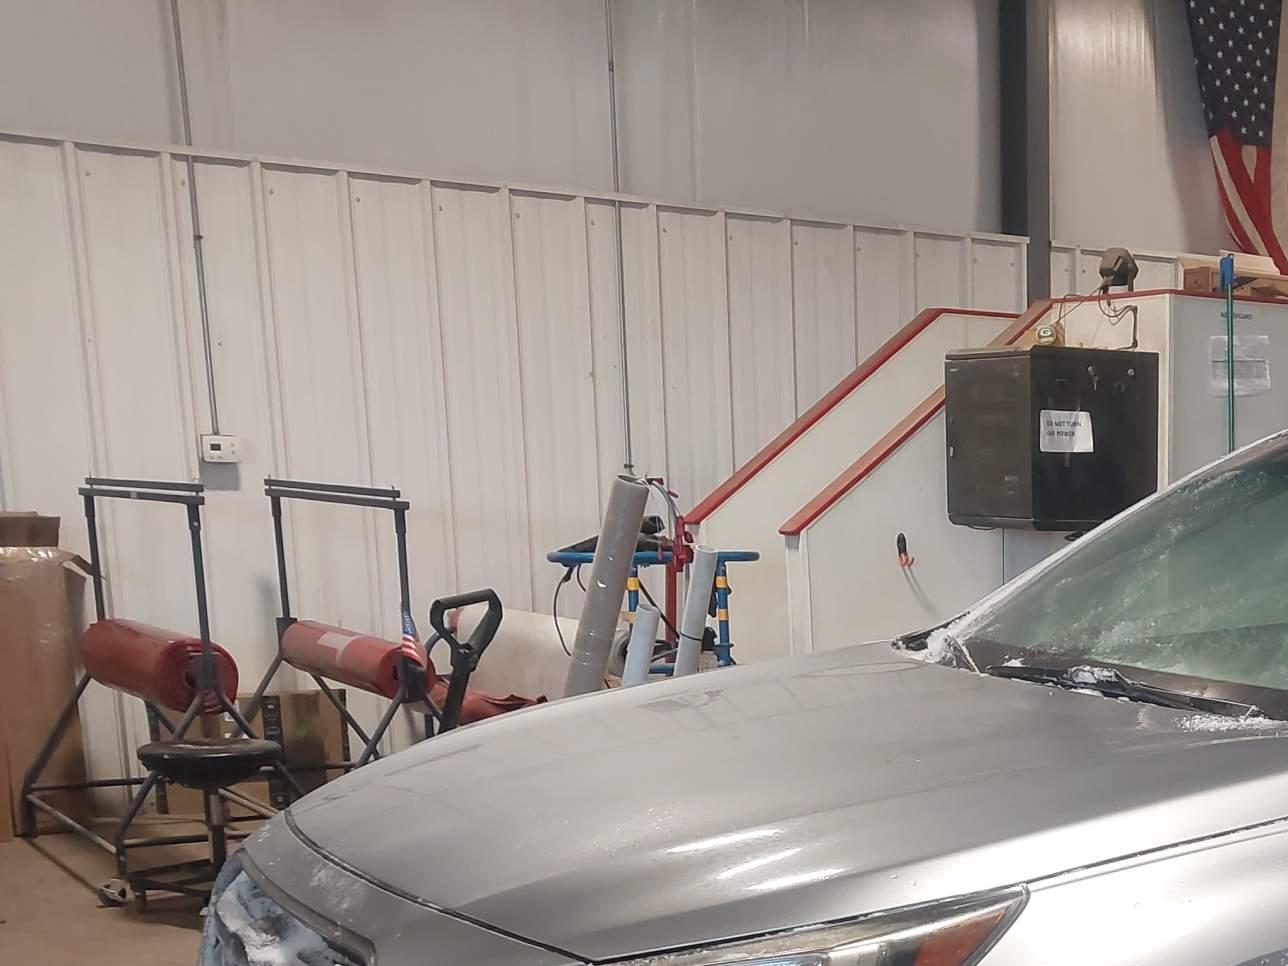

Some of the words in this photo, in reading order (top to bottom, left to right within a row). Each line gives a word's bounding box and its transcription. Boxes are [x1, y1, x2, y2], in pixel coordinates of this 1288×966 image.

[1055, 420, 1066, 428] NOT
[1066, 420, 1082, 428] TURN
[1056, 430, 1076, 438] POWER
